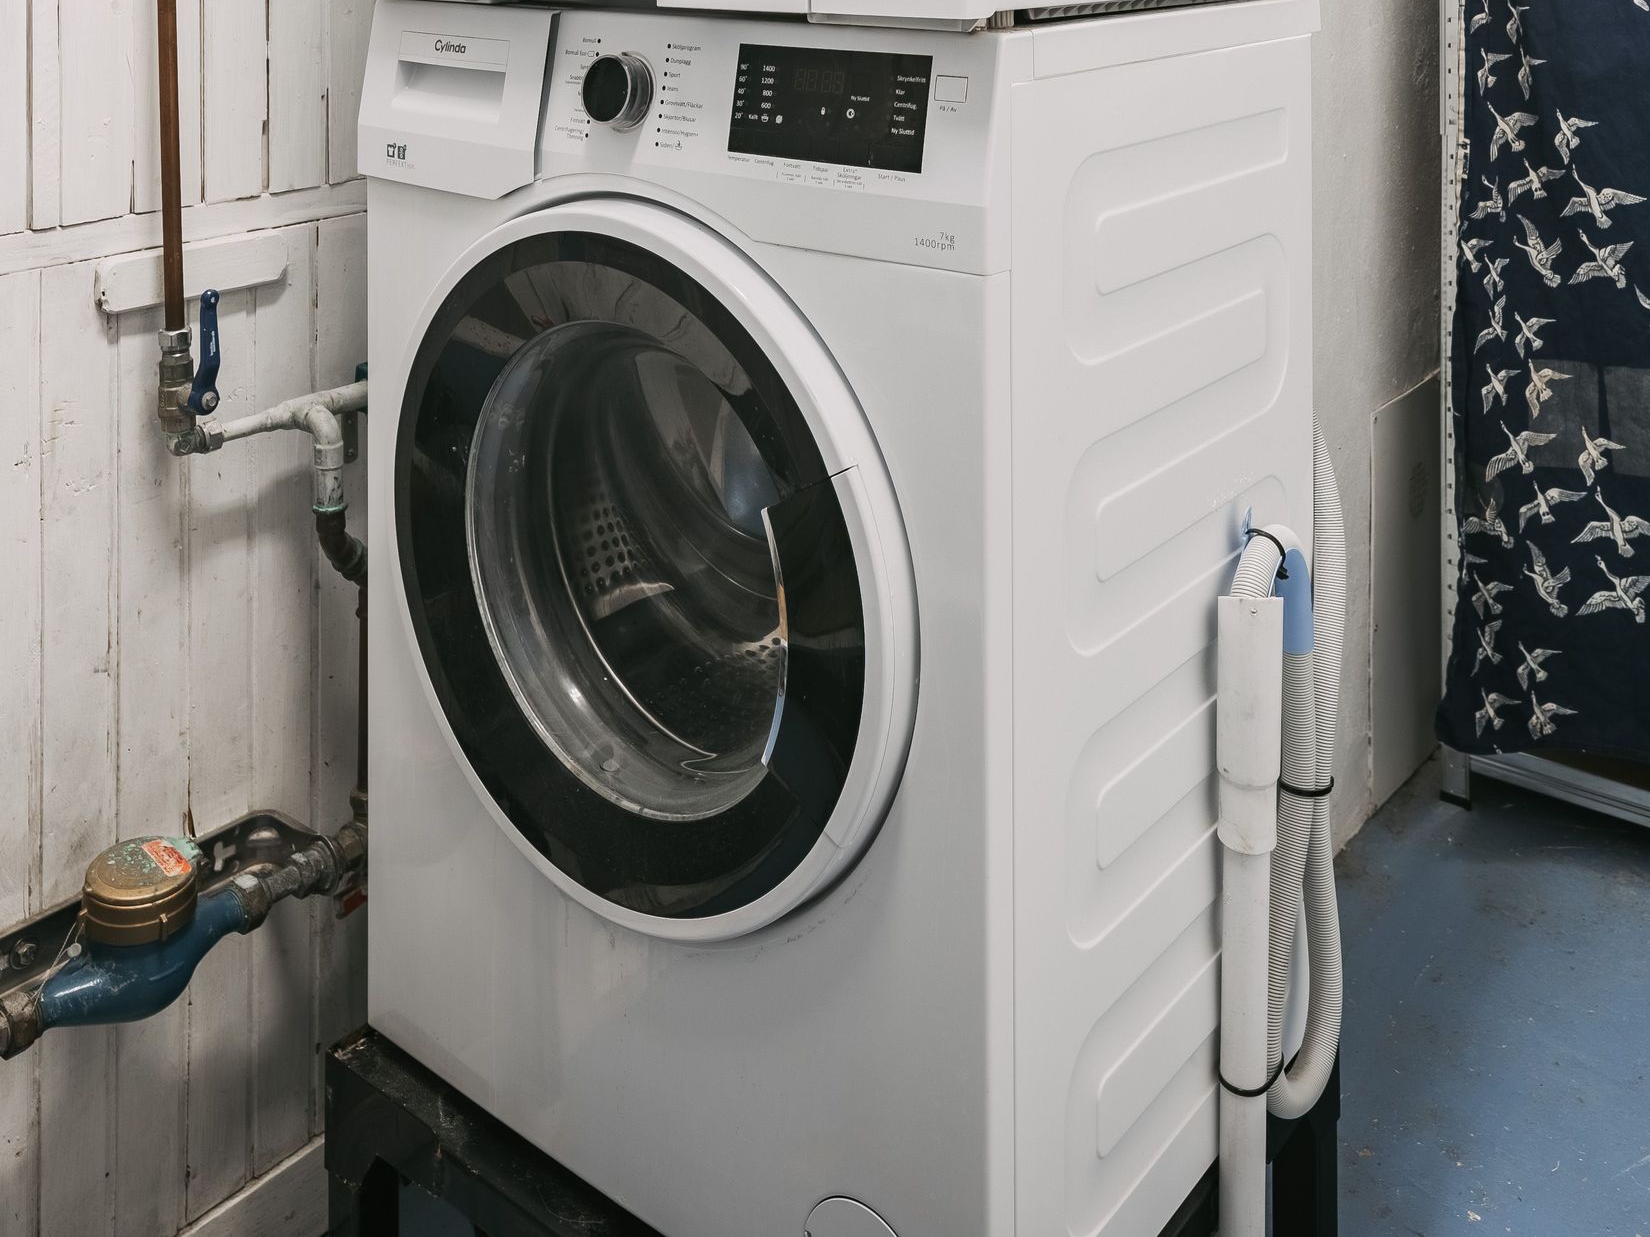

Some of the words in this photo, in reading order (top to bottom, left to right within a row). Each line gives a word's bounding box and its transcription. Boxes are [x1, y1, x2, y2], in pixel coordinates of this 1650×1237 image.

[434, 38, 467, 54] Cylinda
[914, 237, 955, 251] 1400rpm
[939, 231, 955, 244] 7kg
